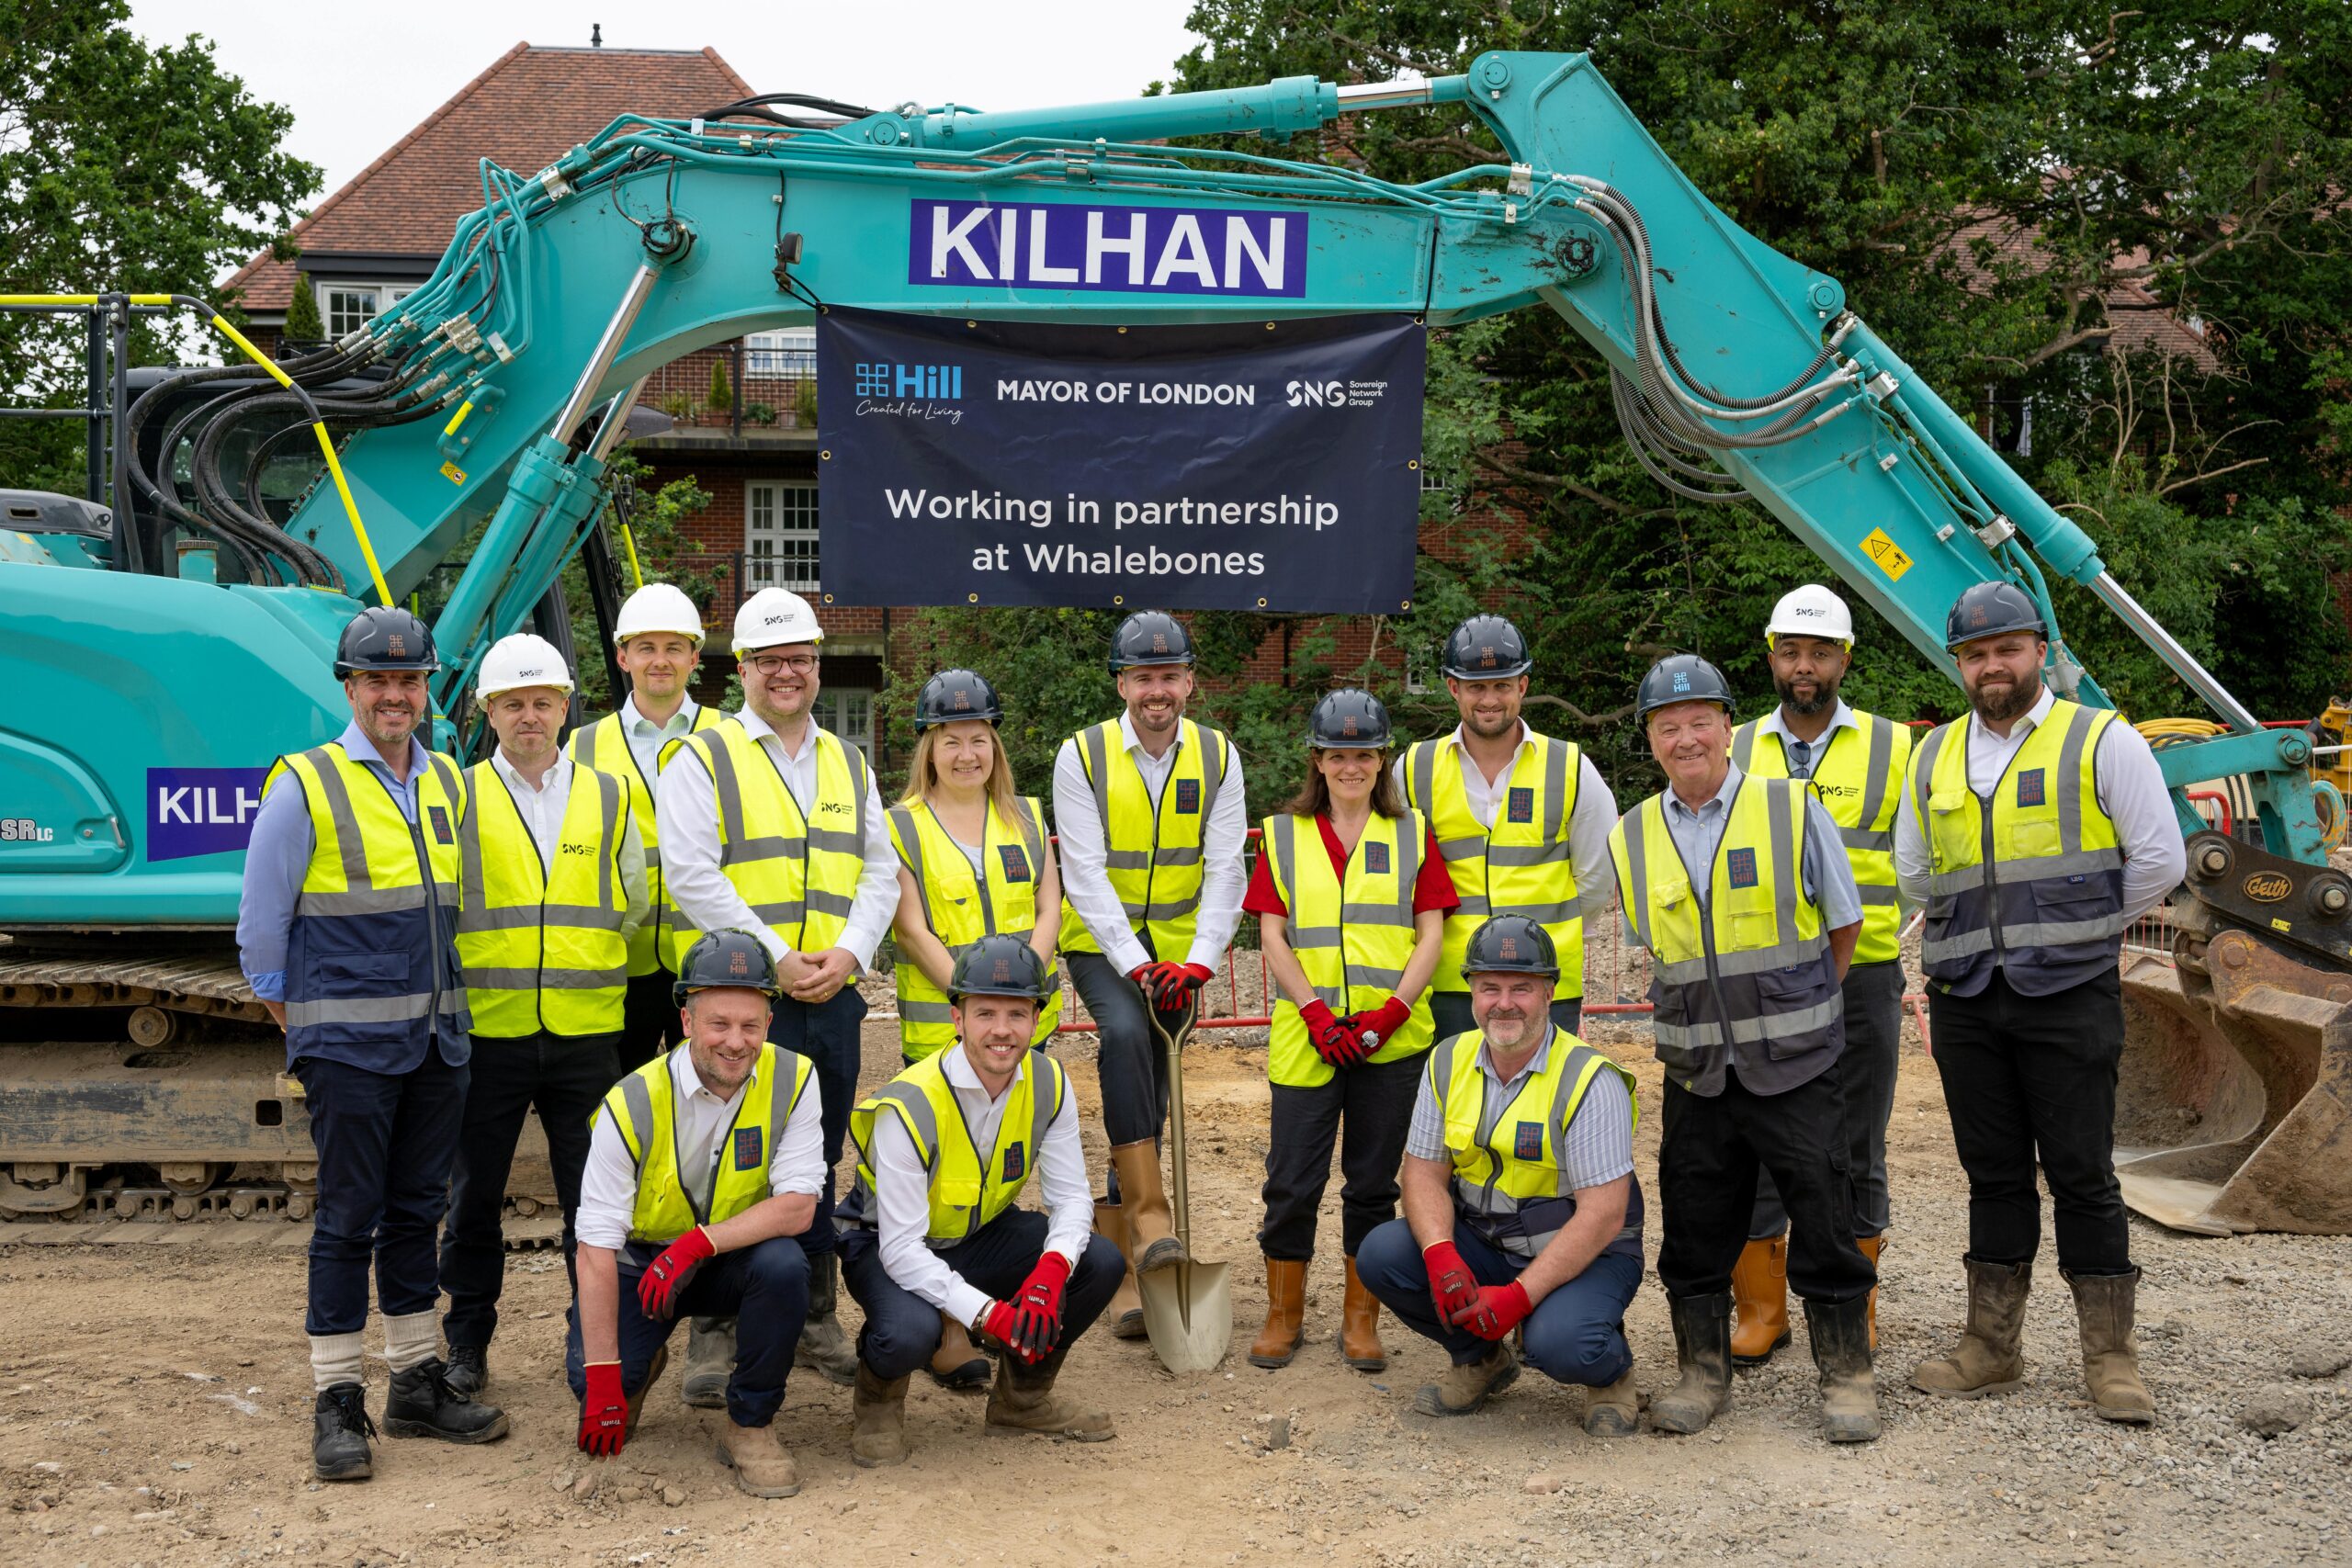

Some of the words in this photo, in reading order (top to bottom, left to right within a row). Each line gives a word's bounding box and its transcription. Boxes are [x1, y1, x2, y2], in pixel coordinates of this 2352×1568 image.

[931, 206, 1286, 290] KILHAN
[896, 365, 962, 399] Hill
[1349, 380, 1388, 389] Sovereign
[997, 379, 1090, 402] MAYOR
[1095, 382, 1132, 403] OF
[1138, 383, 1255, 405] LONDON
[1286, 380, 1346, 408] SNG
[1349, 398, 1374, 407] Group
[855, 400, 905, 416] Created
[907, 402, 923, 418] for
[924, 402, 964, 425] Living
[885, 489, 1052, 528] Working
[1068, 492, 1100, 524] in
[1114, 494, 1340, 531] partnership
[972, 543, 1010, 571] at
[1023, 544, 1265, 575] Whalebones
[1796, 608, 1814, 616] SNG
[764, 615, 784, 625] SNG
[389, 648, 405, 656] Hill
[1153, 645, 1168, 653] Hill
[1481, 658, 1497, 667] Hill
[1673, 682, 1690, 693] Hill
[955, 701, 971, 710] Hill
[1342, 728, 1358, 736] Hill
[1819, 785, 1843, 796] SNG
[562, 843, 584, 855] SNG
[1007, 865, 1028, 877] Hill
[1733, 872, 1754, 884] Hill
[1499, 950, 1517, 960] Hill
[729, 964, 748, 974] Hill
[1518, 1146, 1538, 1157] Hill
[739, 1153, 759, 1166] Hill
